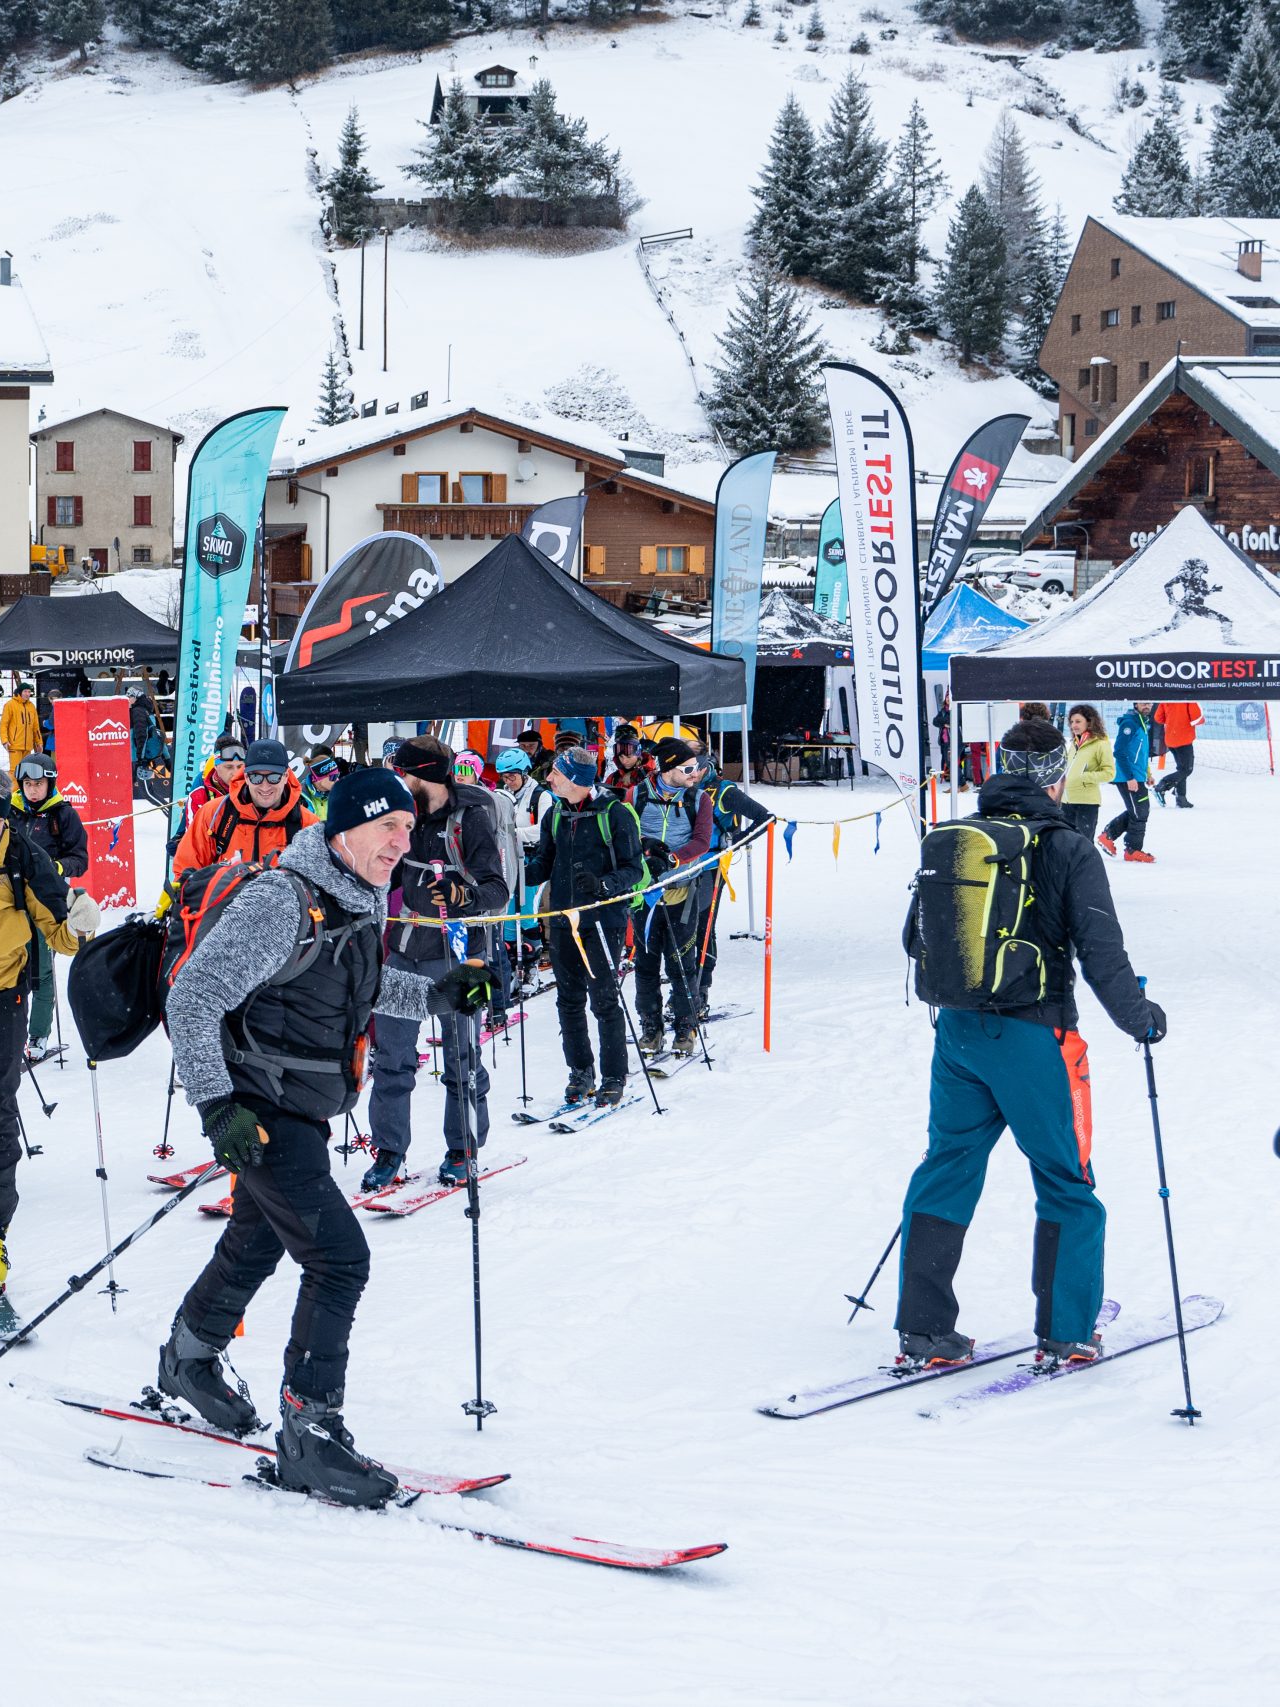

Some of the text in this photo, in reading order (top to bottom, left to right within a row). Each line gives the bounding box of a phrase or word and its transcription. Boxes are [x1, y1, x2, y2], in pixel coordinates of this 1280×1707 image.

[203, 536, 233, 556] SKMO
[727, 503, 753, 573] LAND
[1242, 524, 1280, 551] font
[819, 593, 829, 615] tival
[723, 599, 746, 657] OME
[65, 648, 135, 661] black hole
[1095, 660, 1280, 680] OUTDOORTEST.IT
[199, 615, 224, 756] scialpinismo
[185, 639, 202, 796] primo festival
[88, 727, 129, 741] bormio
[63, 791, 88, 803] ormio
[363, 797, 389, 818] HH
